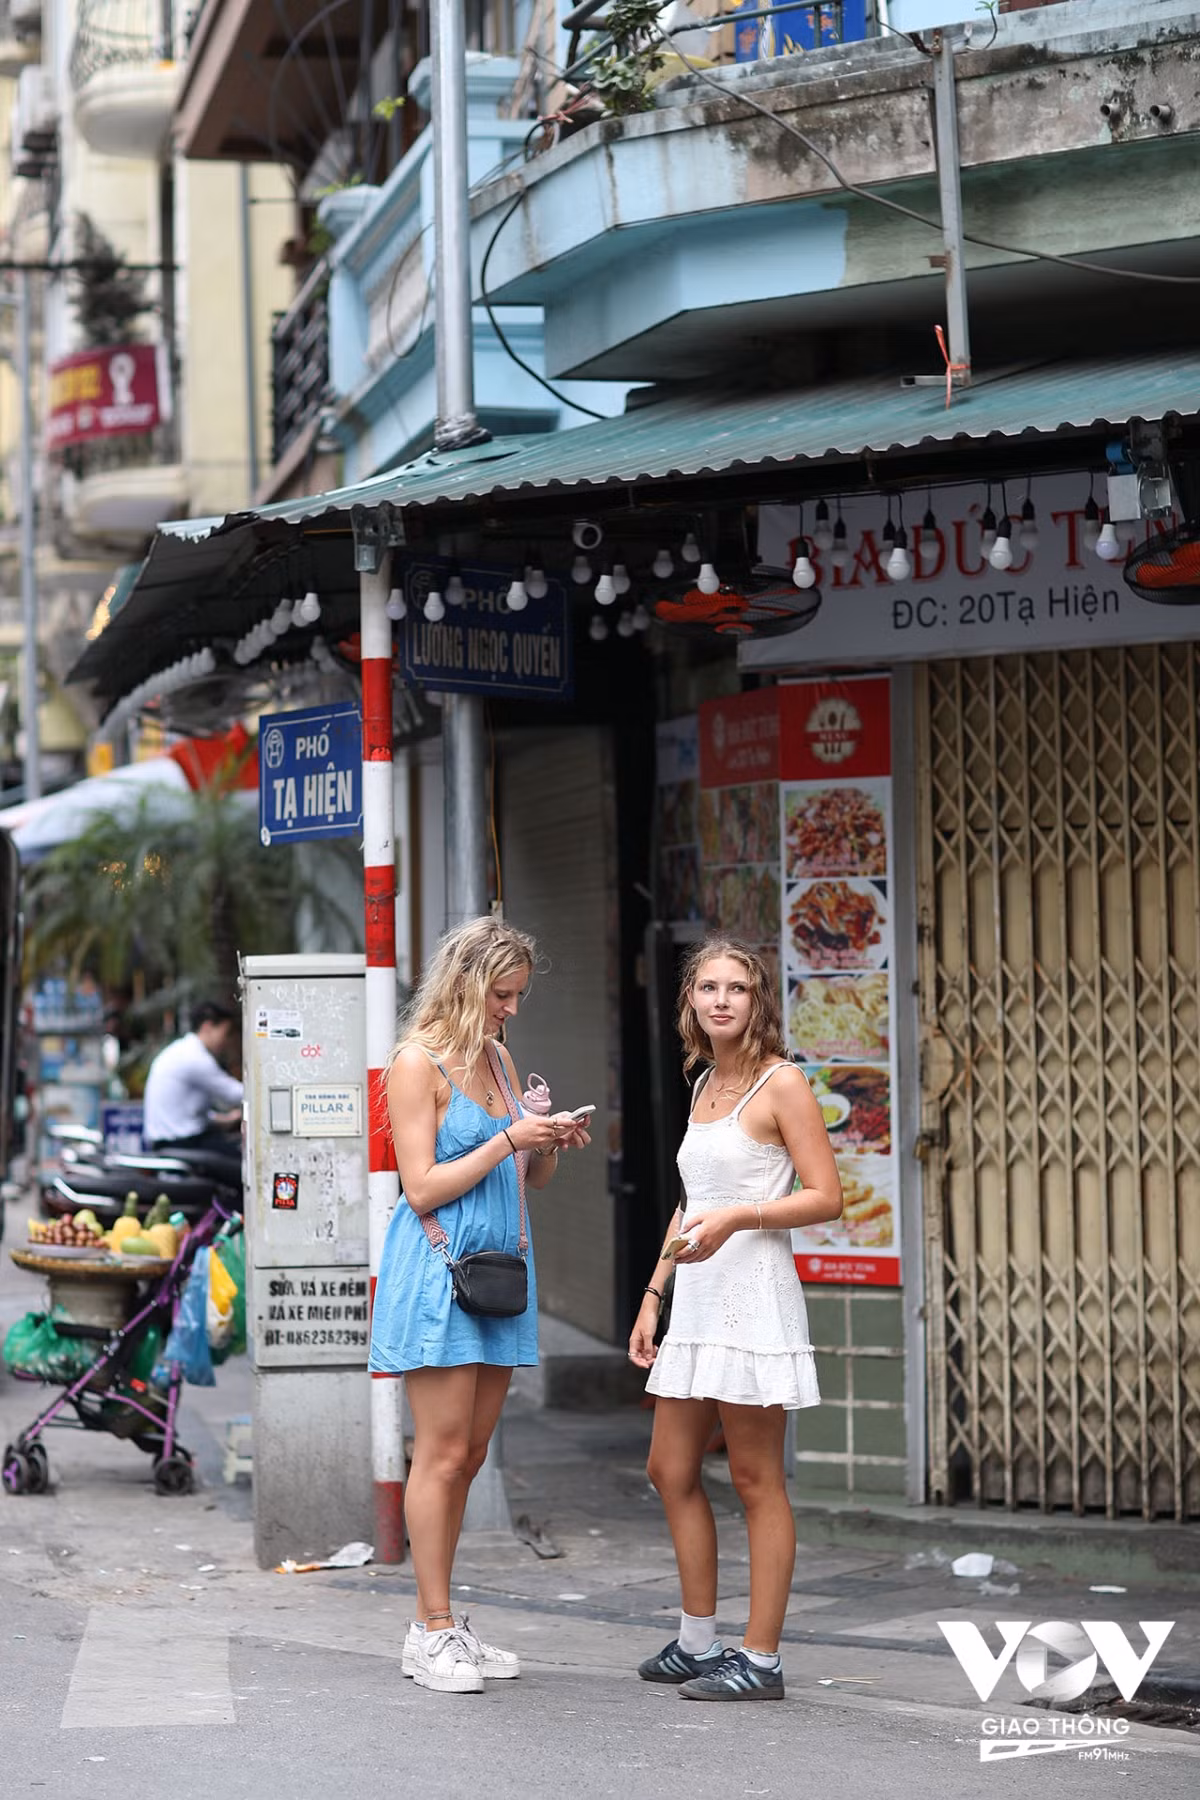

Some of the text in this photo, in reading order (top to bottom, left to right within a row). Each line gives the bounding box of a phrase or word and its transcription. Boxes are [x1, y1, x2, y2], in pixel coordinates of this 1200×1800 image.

[892, 585, 1119, 629] ĐC: 20Tạ Hiện
[412, 622, 561, 682] LƯƠNG NGỌC QUYẾN
[295, 723, 330, 761] PHỐ
[273, 763, 353, 828] TẠ HIỆN
[300, 1103, 354, 1114] PILLAR 4
[300, 1276, 317, 1297] VÁ
[320, 1281, 336, 1297] XE
[288, 1305, 304, 1321] XE
